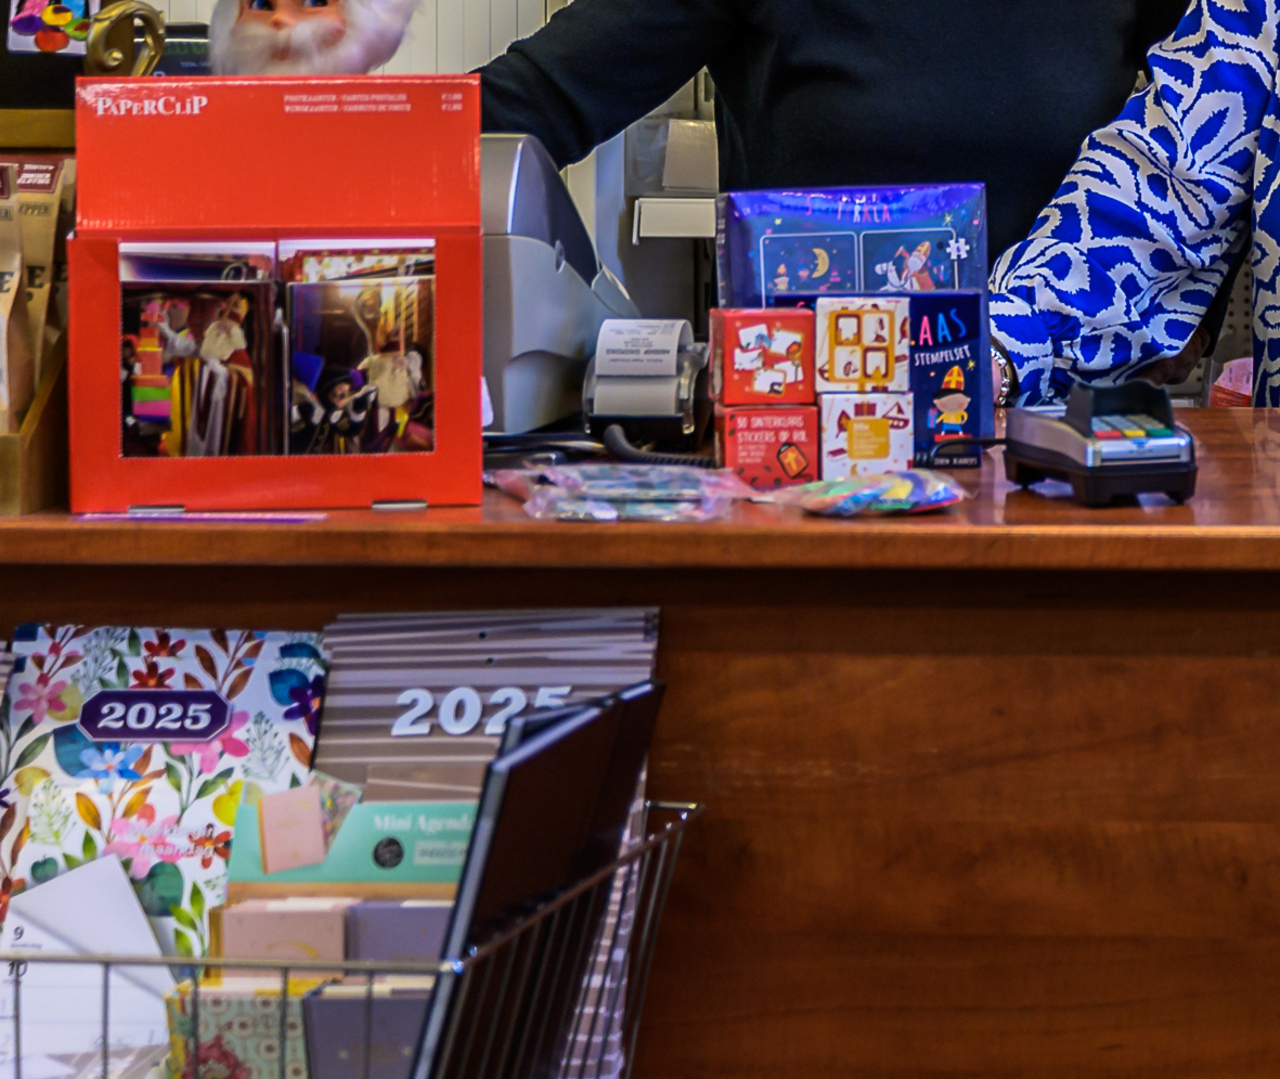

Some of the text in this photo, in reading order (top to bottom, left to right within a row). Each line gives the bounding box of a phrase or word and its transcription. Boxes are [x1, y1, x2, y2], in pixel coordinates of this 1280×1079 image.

[914, 345, 971, 367] STEMPELSET
[737, 430, 775, 444] STICKERS
[779, 430, 790, 443] OP
[100, 701, 213, 732] 2025
[13, 926, 24, 941] 9
